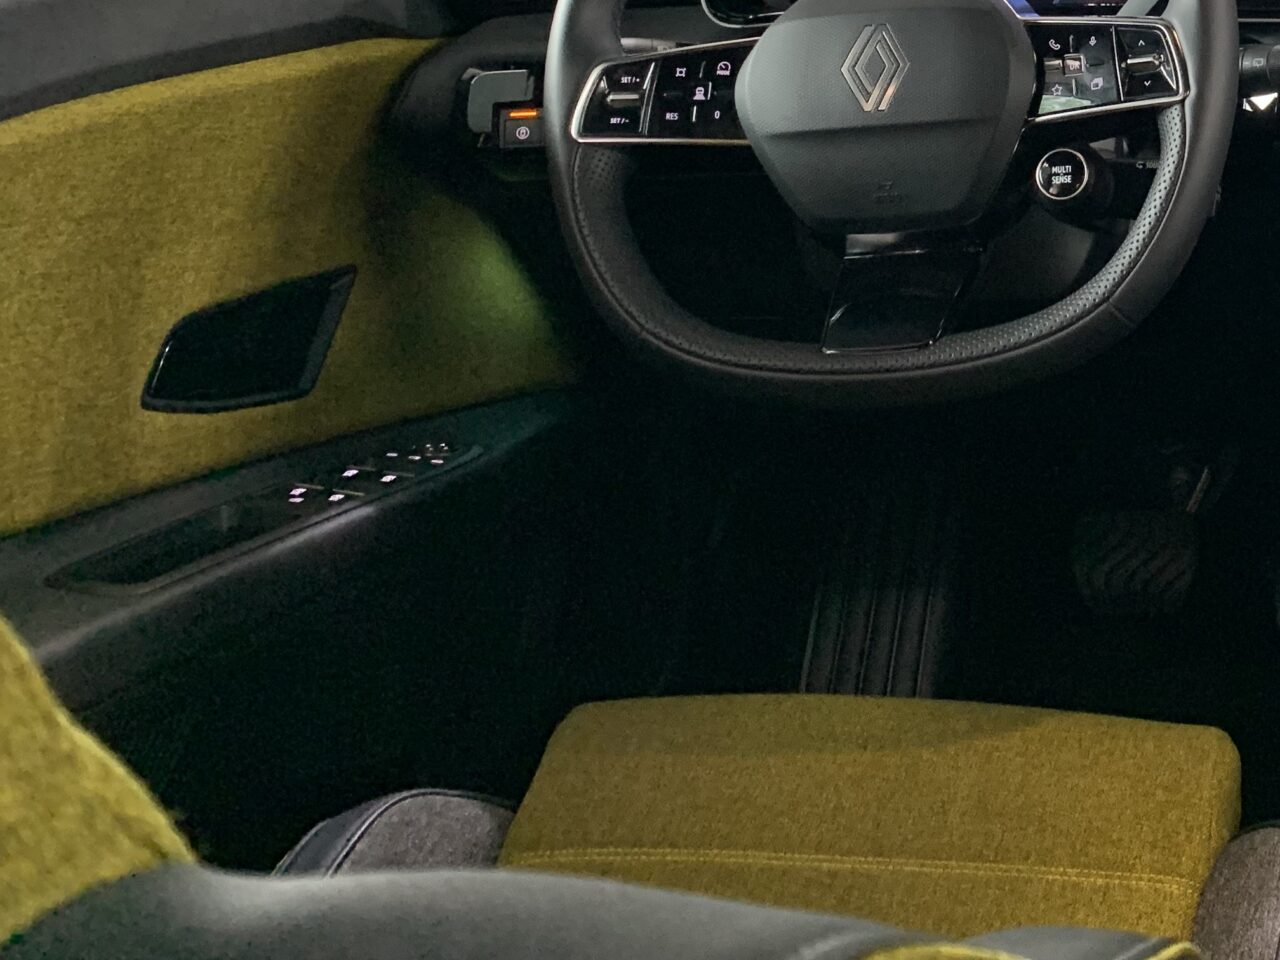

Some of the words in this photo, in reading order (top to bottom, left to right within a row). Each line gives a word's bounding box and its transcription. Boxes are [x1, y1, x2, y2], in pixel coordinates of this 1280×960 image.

[665, 112, 679, 121] RES
[1051, 165, 1072, 174] MULTI
[1051, 175, 1072, 184] SENSE
